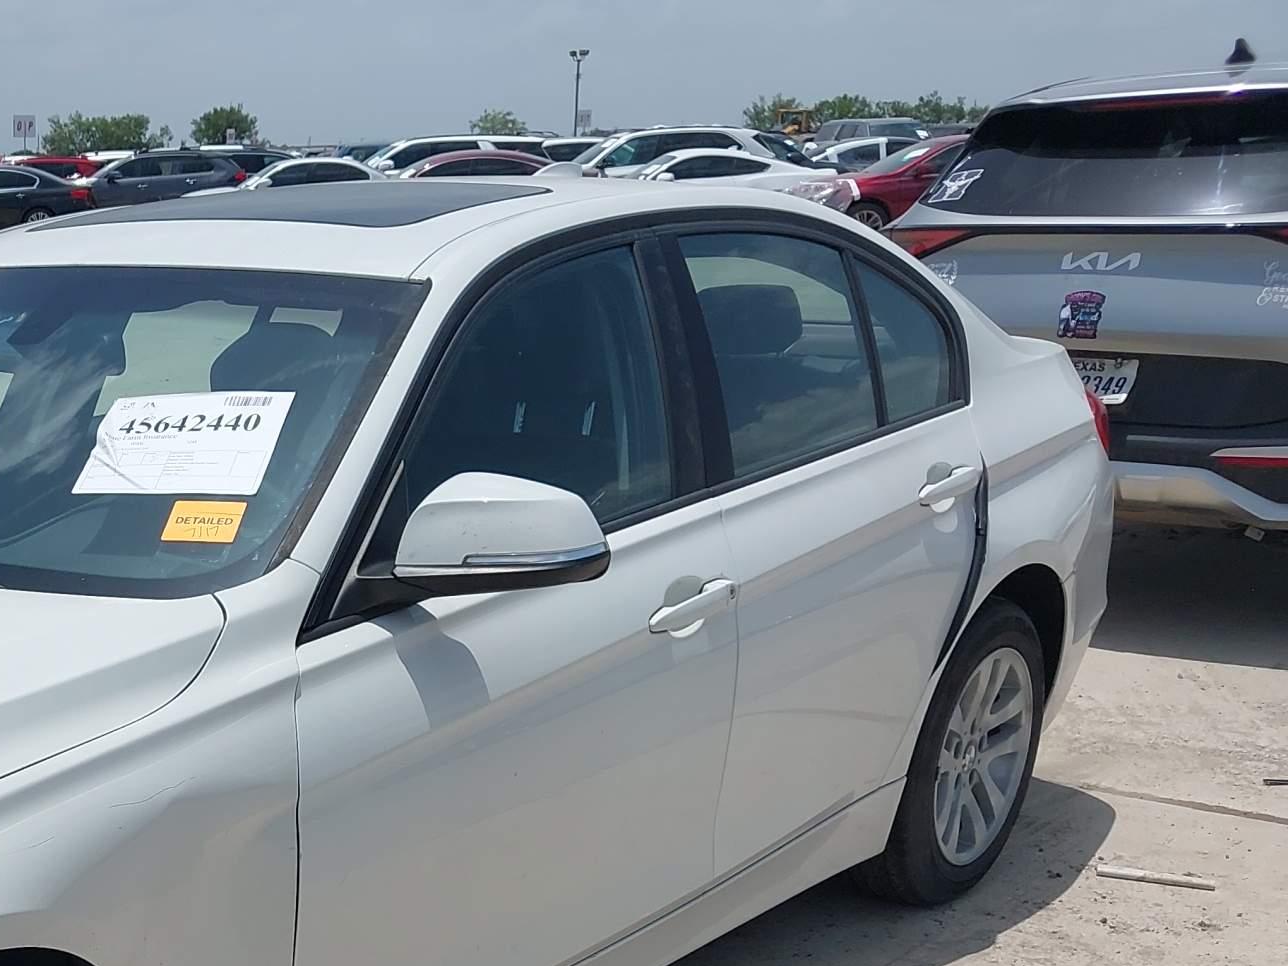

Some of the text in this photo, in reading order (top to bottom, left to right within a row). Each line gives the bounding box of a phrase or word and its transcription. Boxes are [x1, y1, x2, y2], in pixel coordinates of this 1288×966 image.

[1061, 252, 1141, 270] KIA
[1072, 361, 1106, 371] EXAS
[119, 414, 261, 434] 45642440
[175, 516, 234, 526] DETAILED
